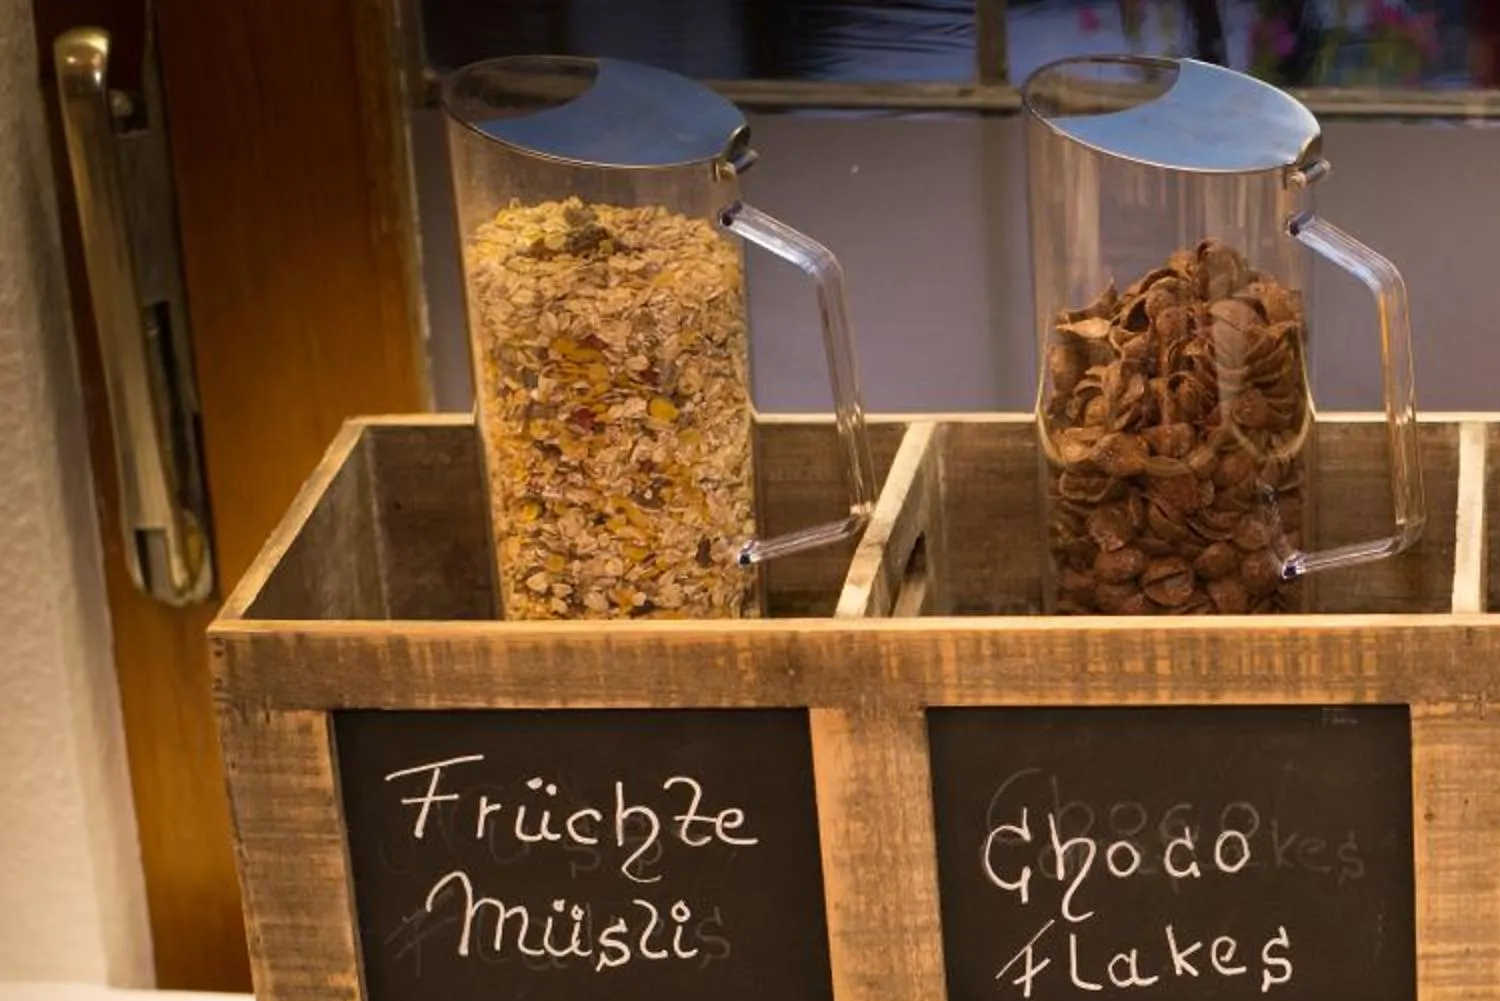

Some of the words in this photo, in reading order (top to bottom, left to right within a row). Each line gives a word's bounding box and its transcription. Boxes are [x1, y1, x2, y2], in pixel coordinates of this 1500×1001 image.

[384, 754, 759, 884] Früchte
[984, 806, 1252, 922] Choco
[425, 870, 700, 973] Müsli
[994, 918, 1295, 999] Flakes
